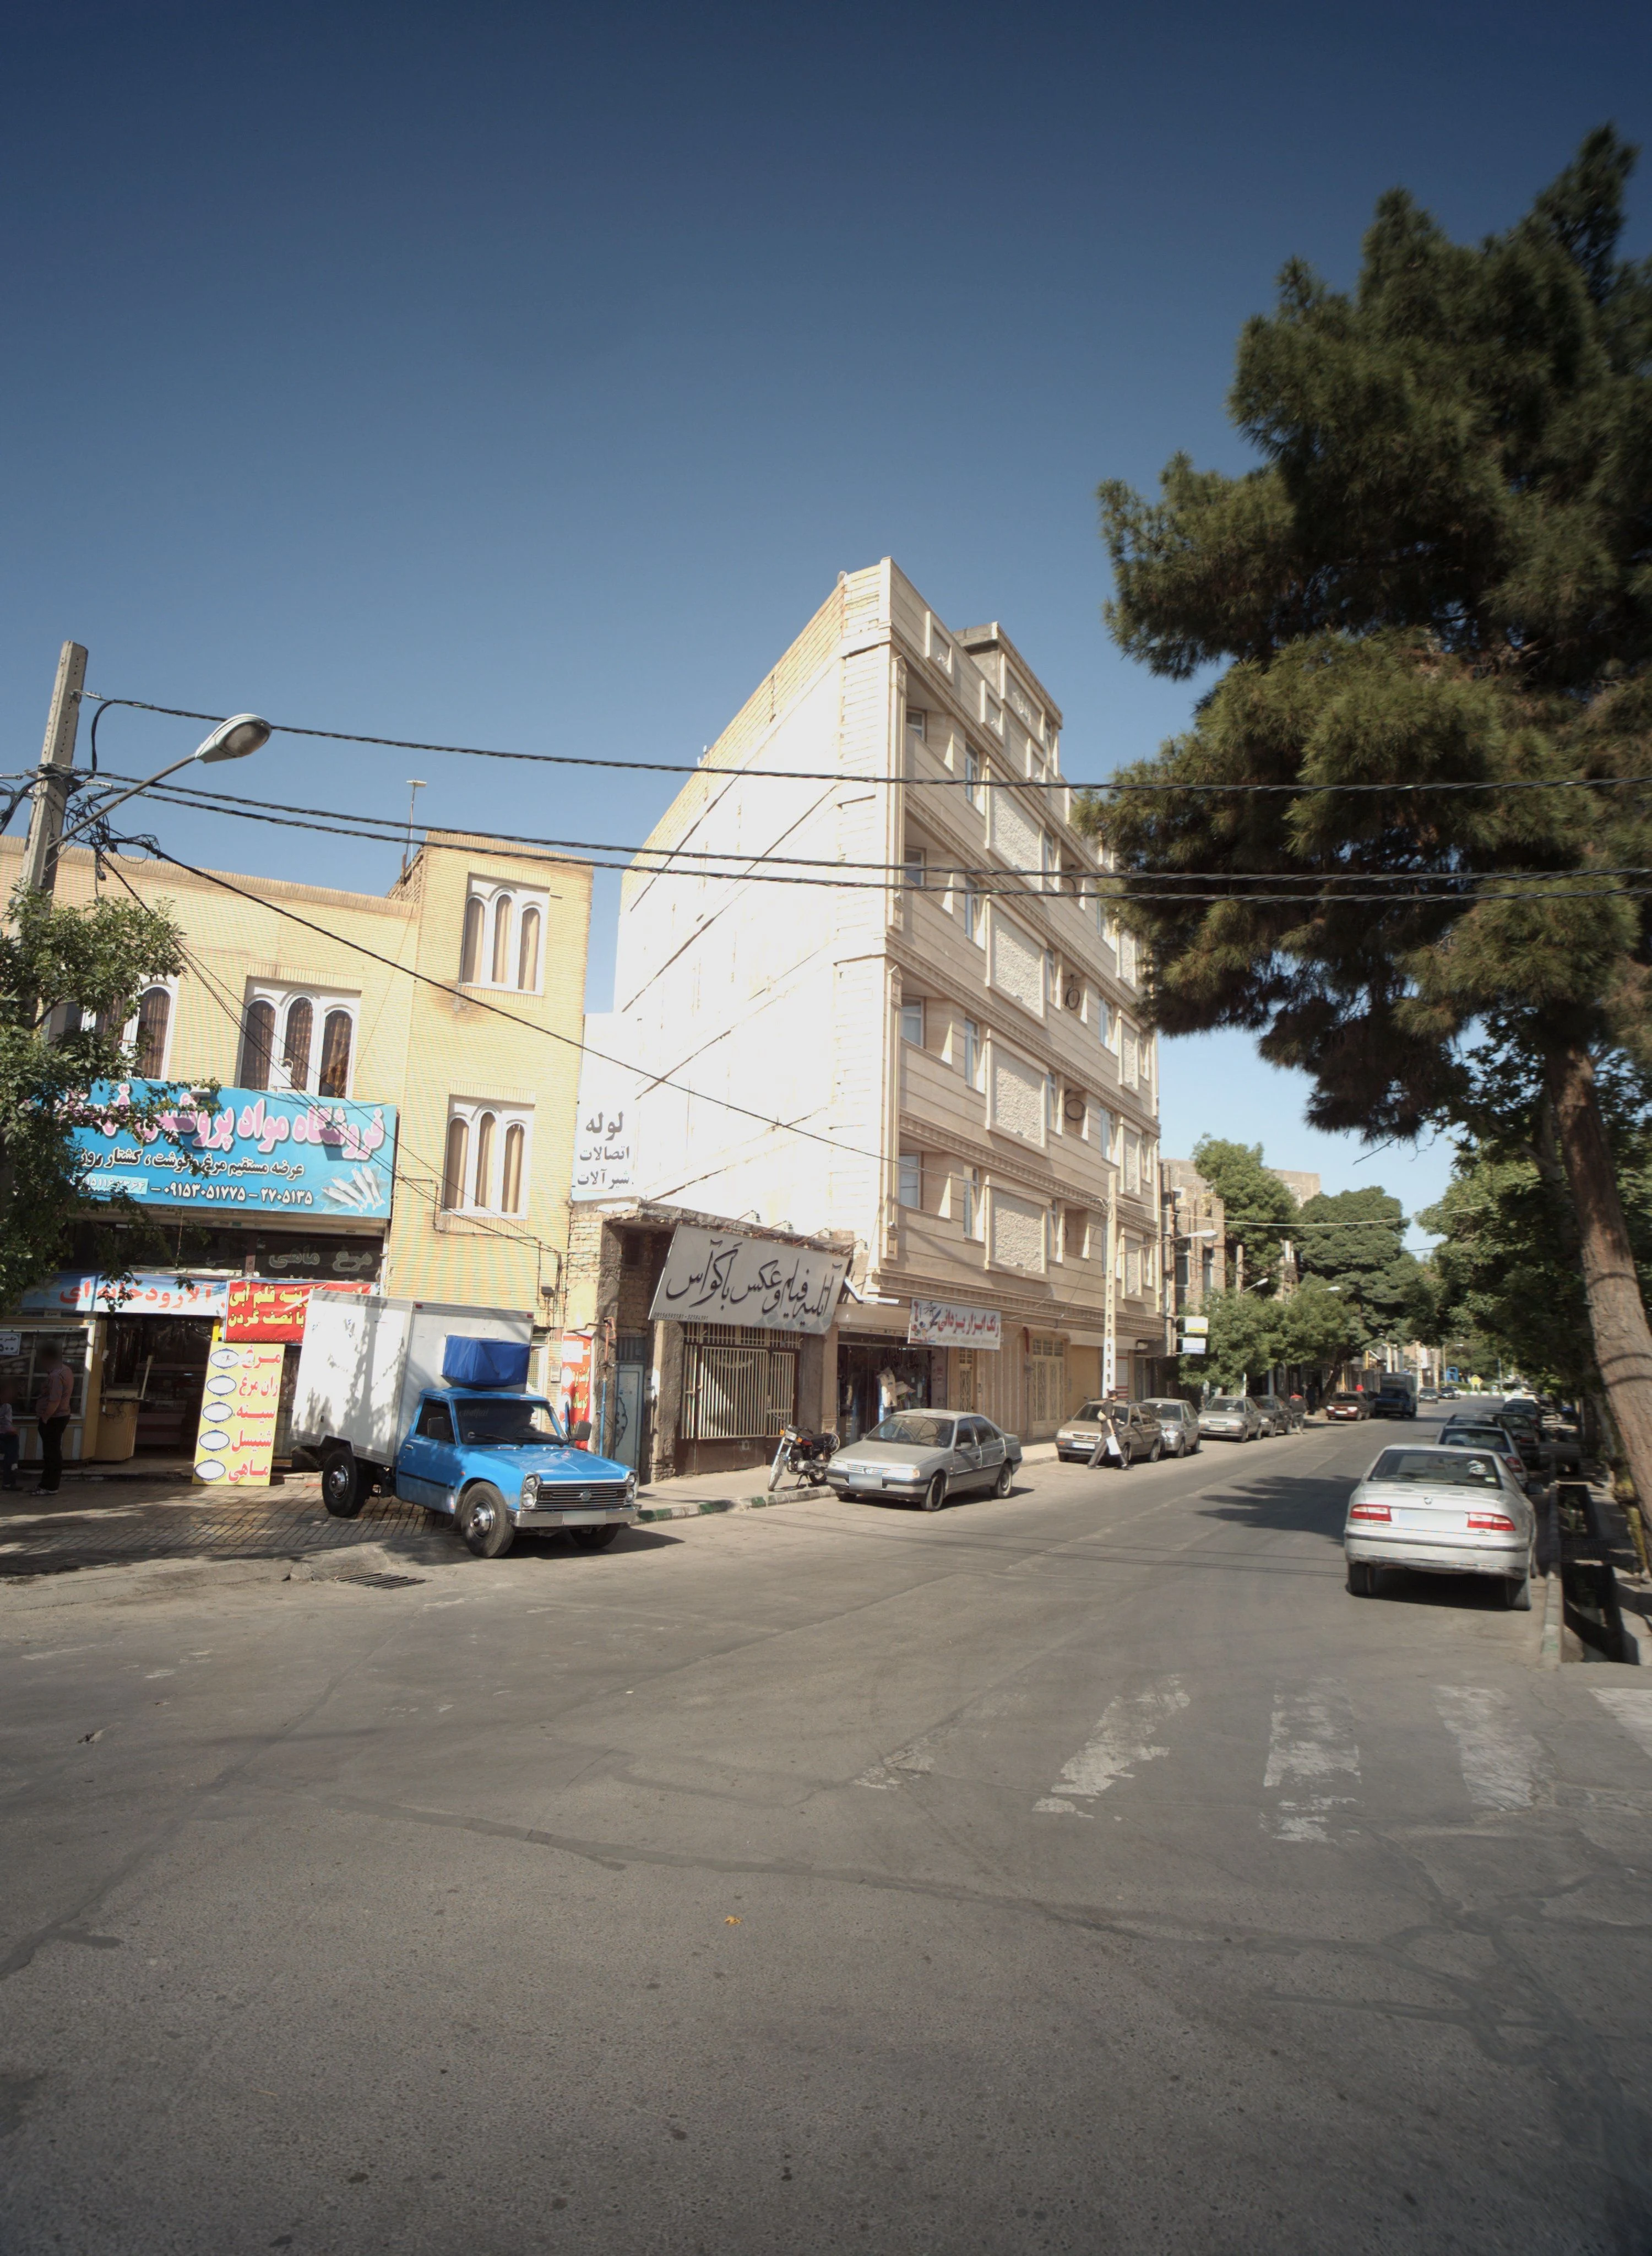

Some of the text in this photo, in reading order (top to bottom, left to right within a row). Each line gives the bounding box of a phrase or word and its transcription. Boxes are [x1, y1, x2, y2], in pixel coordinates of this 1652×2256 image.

[237, 1098, 289, 1152] مواد
[292, 1104, 385, 1160] فروشگاه
[586, 1111, 624, 1141] لوله
[104, 1147, 144, 1168] کشتار
[202, 1153, 226, 1175] مرغ
[580, 1146, 629, 1161] اتصالات
[228, 1157, 268, 1176] مستقیم
[270, 1160, 304, 1180] عرضه
[578, 1168, 629, 1189] شیر آلات
[164, 1181, 246, 1201] ۰۹۱۵۳۰۵۱۷۷۵
[260, 1187, 313, 1205] ۲۷۰۵۱۳۵
[269, 1246, 320, 1268] ماهی
[730, 1260, 782, 1304] عکس
[780, 1258, 810, 1318] فیلم
[253, 1285, 275, 1309] قلم
[762, 1289, 781, 1314] و
[792, 1262, 843, 1326] آتلیه
[227, 1310, 259, 1327] گردن
[263, 1311, 292, 1325] نصف
[938, 1308, 999, 1338] رنگ ابزار یزدانی
[238, 1373, 278, 1397] ران مرغ
[236, 1404, 275, 1424] سینه
[231, 1429, 273, 1453] شنیسل
[228, 1459, 269, 1482] ماهی
